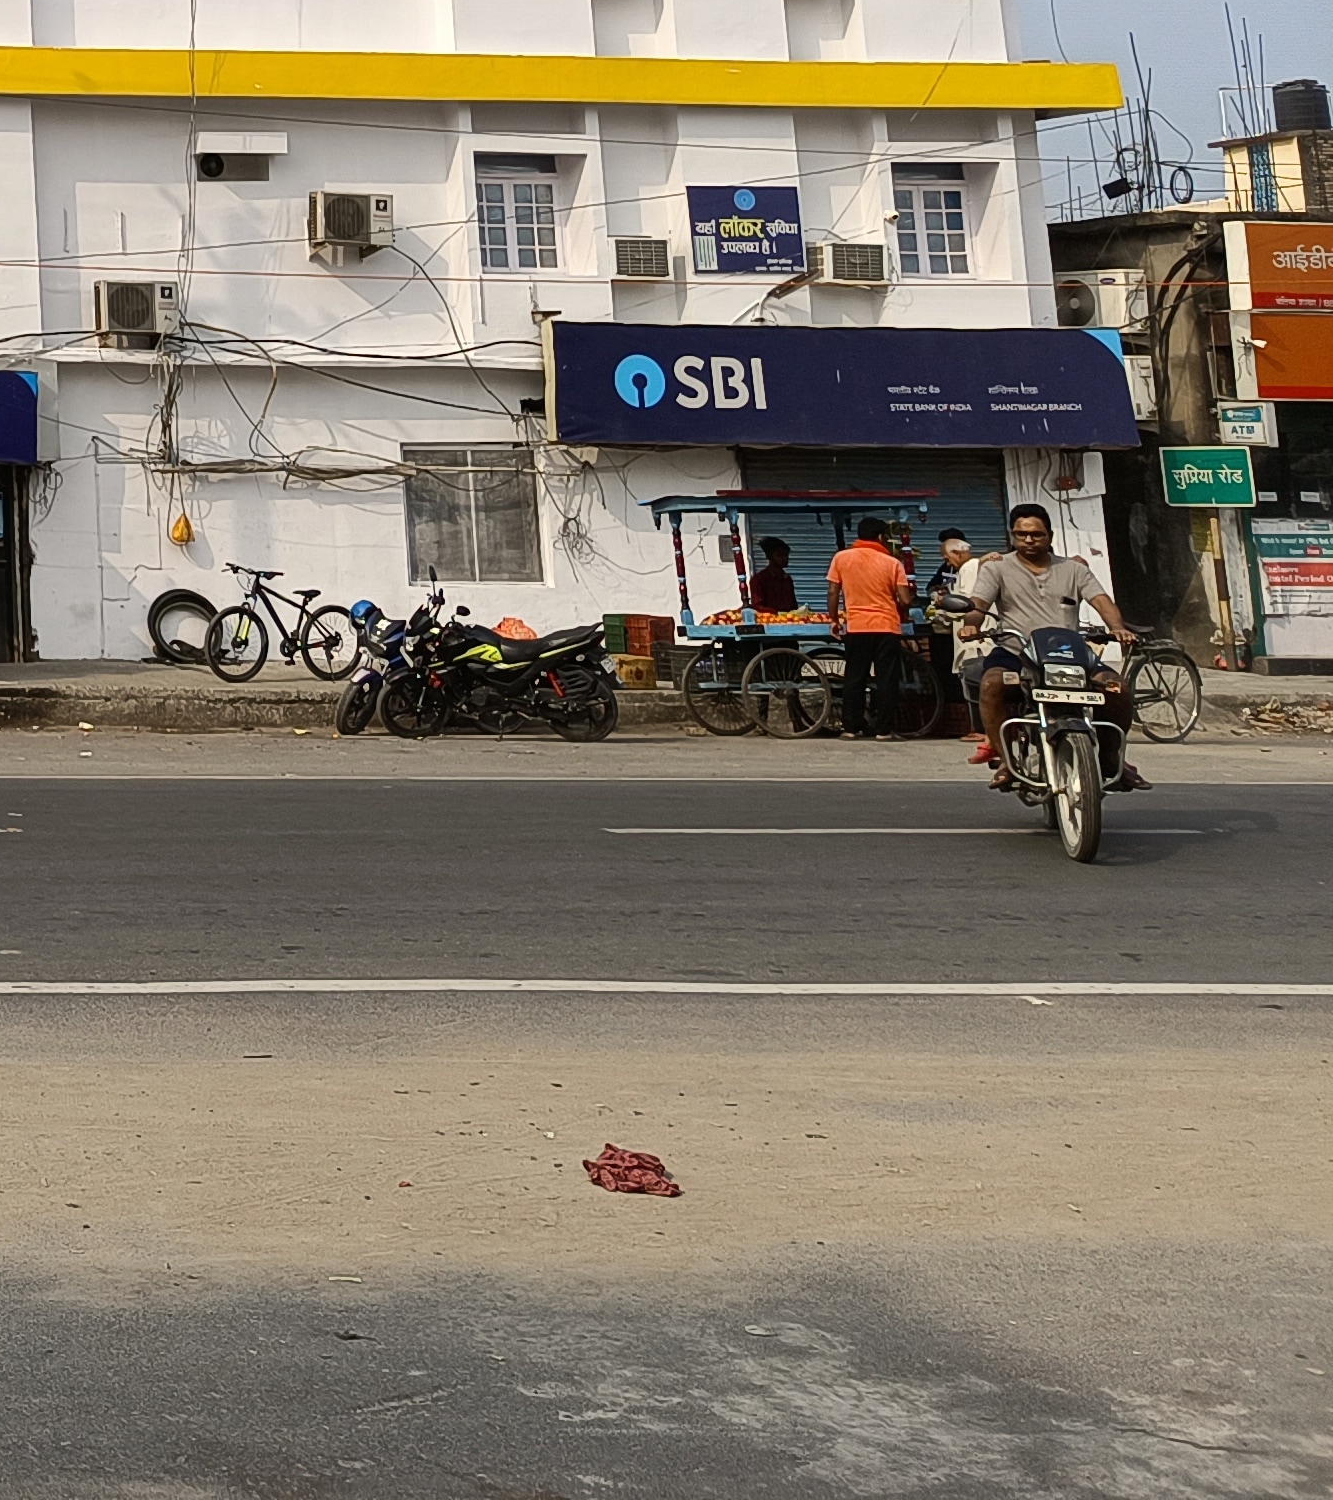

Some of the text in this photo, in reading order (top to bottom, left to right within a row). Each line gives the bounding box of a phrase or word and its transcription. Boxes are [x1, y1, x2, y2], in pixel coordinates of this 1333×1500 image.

[719, 215, 765, 238] लॉकर
[673, 355, 767, 409] SBI
[1231, 425, 1255, 435] ATM
[1171, 464, 1243, 489] सुप्रिया रोड
